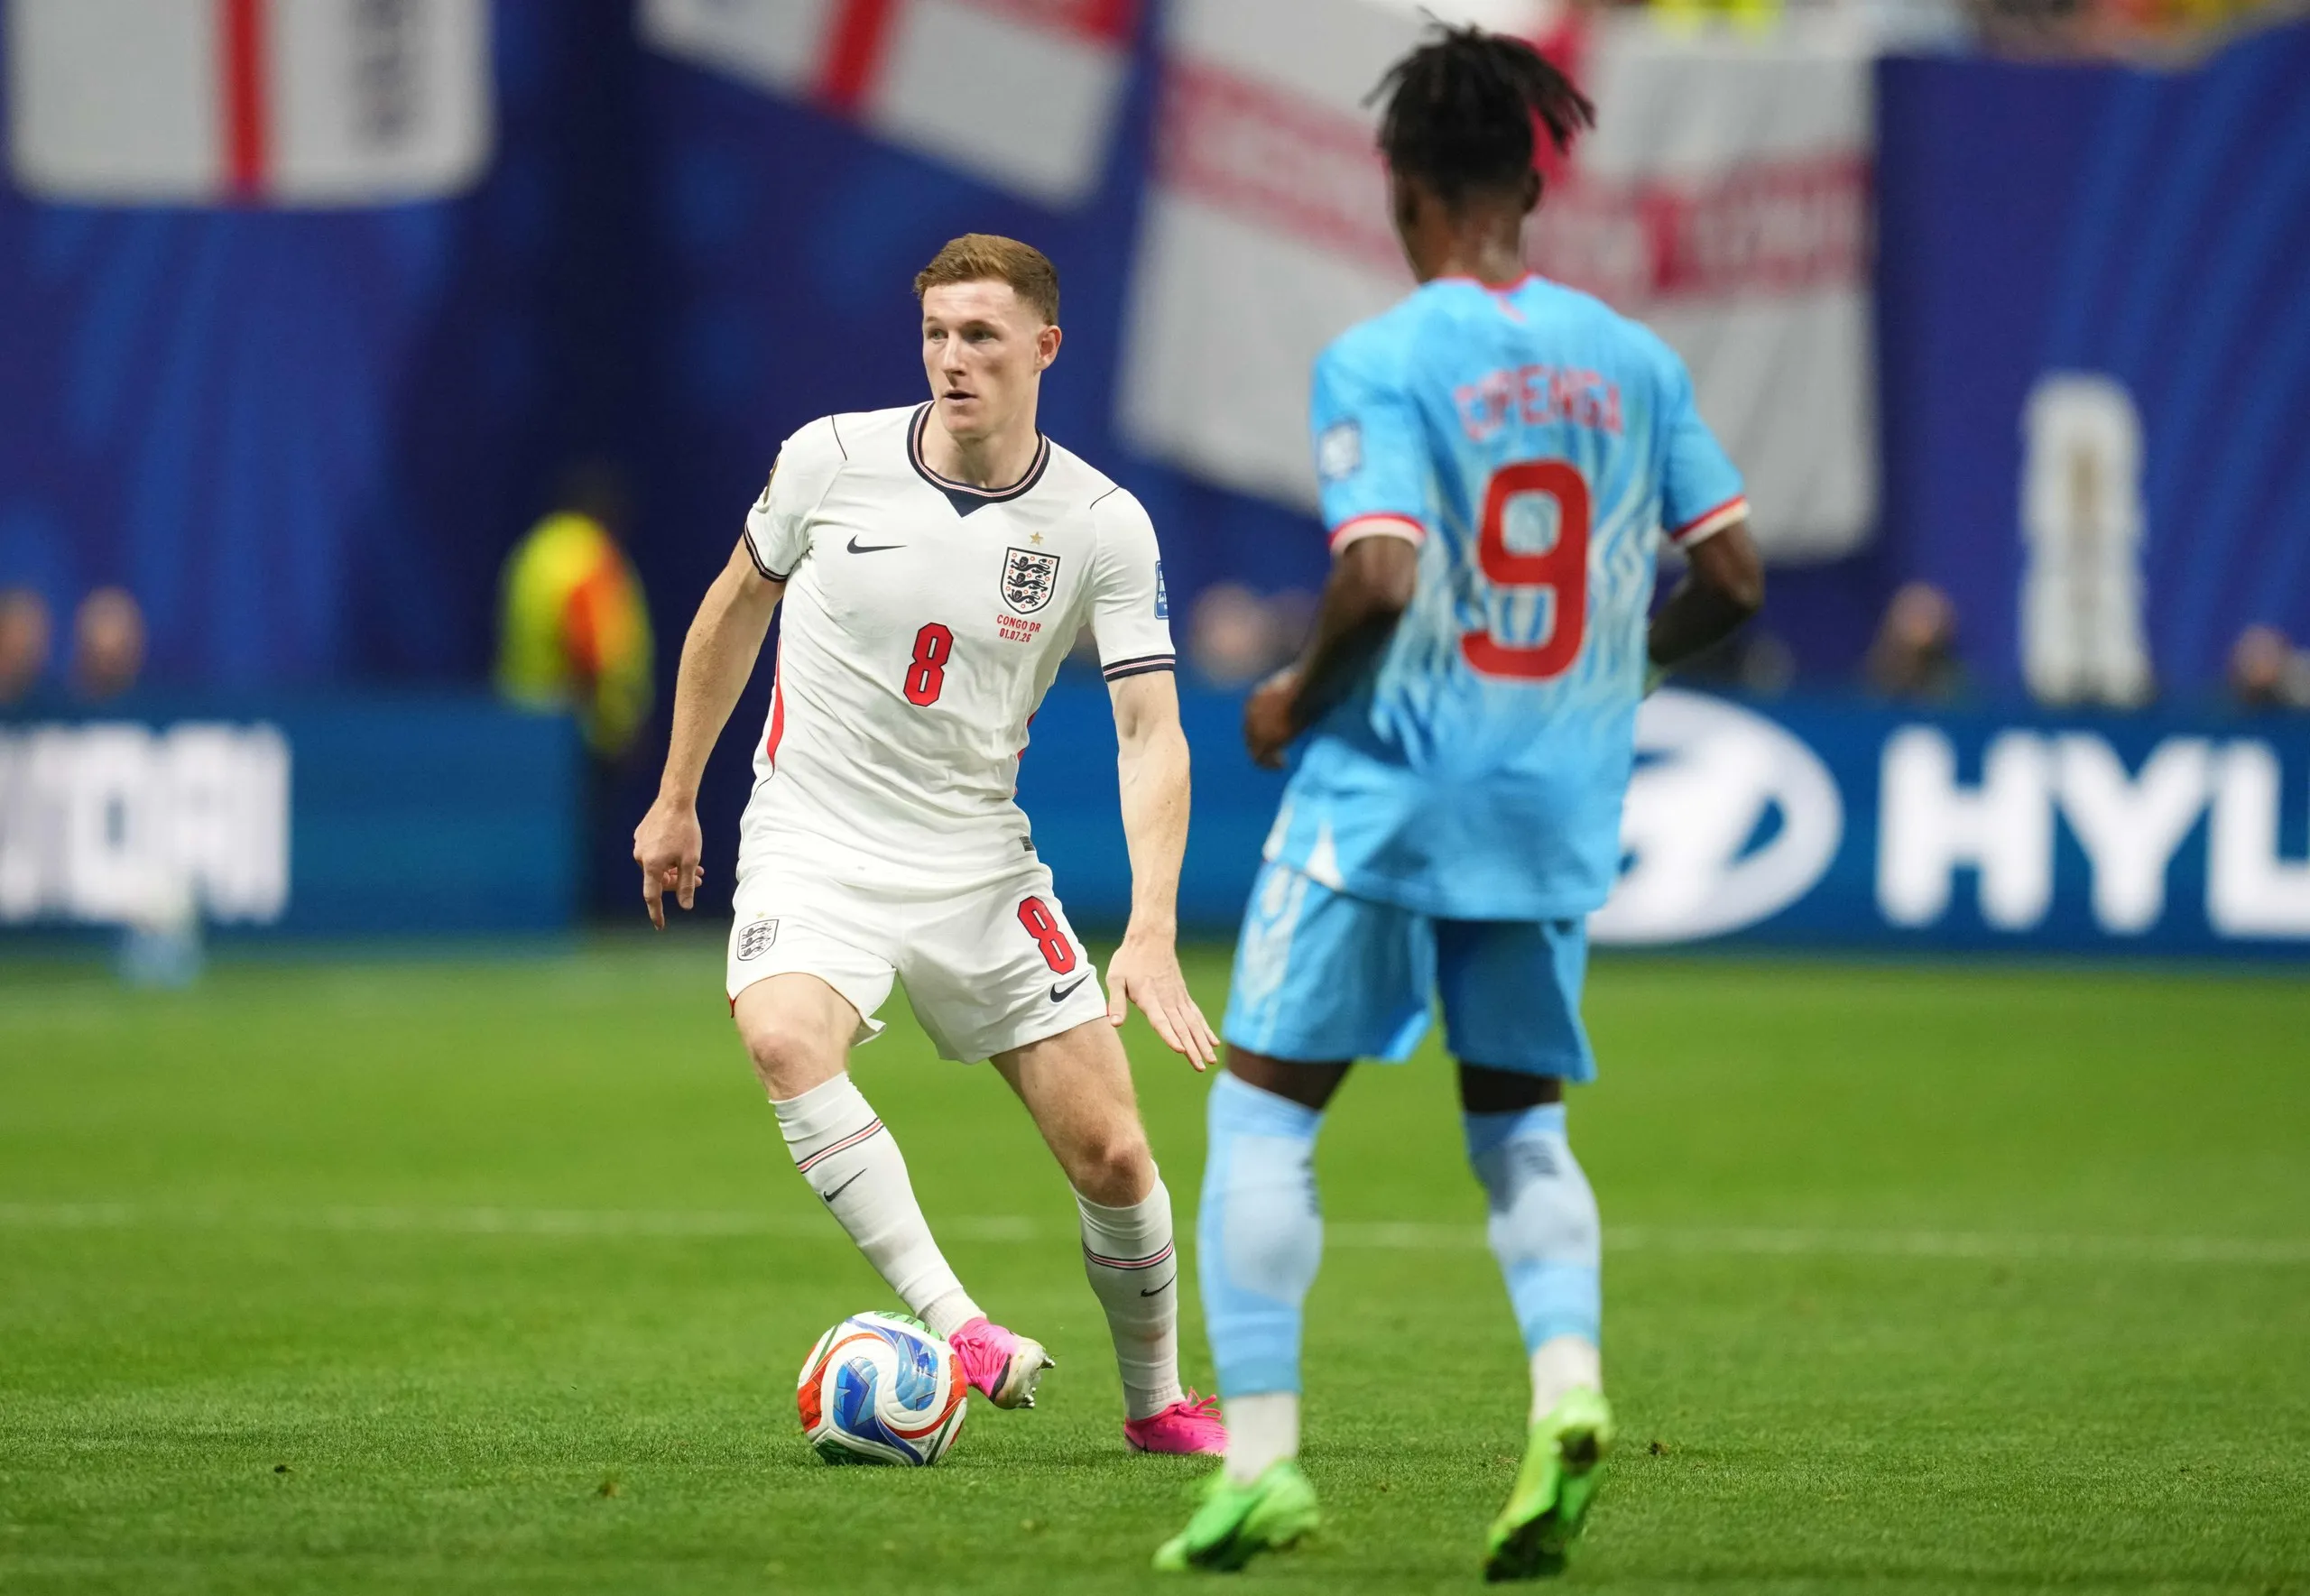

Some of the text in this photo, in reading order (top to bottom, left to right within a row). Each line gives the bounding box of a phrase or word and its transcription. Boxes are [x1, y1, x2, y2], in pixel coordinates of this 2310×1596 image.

[1460, 459, 1592, 682] 9
[996, 614, 1041, 633] CONGO DR
[999, 627, 1032, 643] 01.07.26
[902, 622, 954, 707] 8
[1017, 895, 1077, 975] 8
